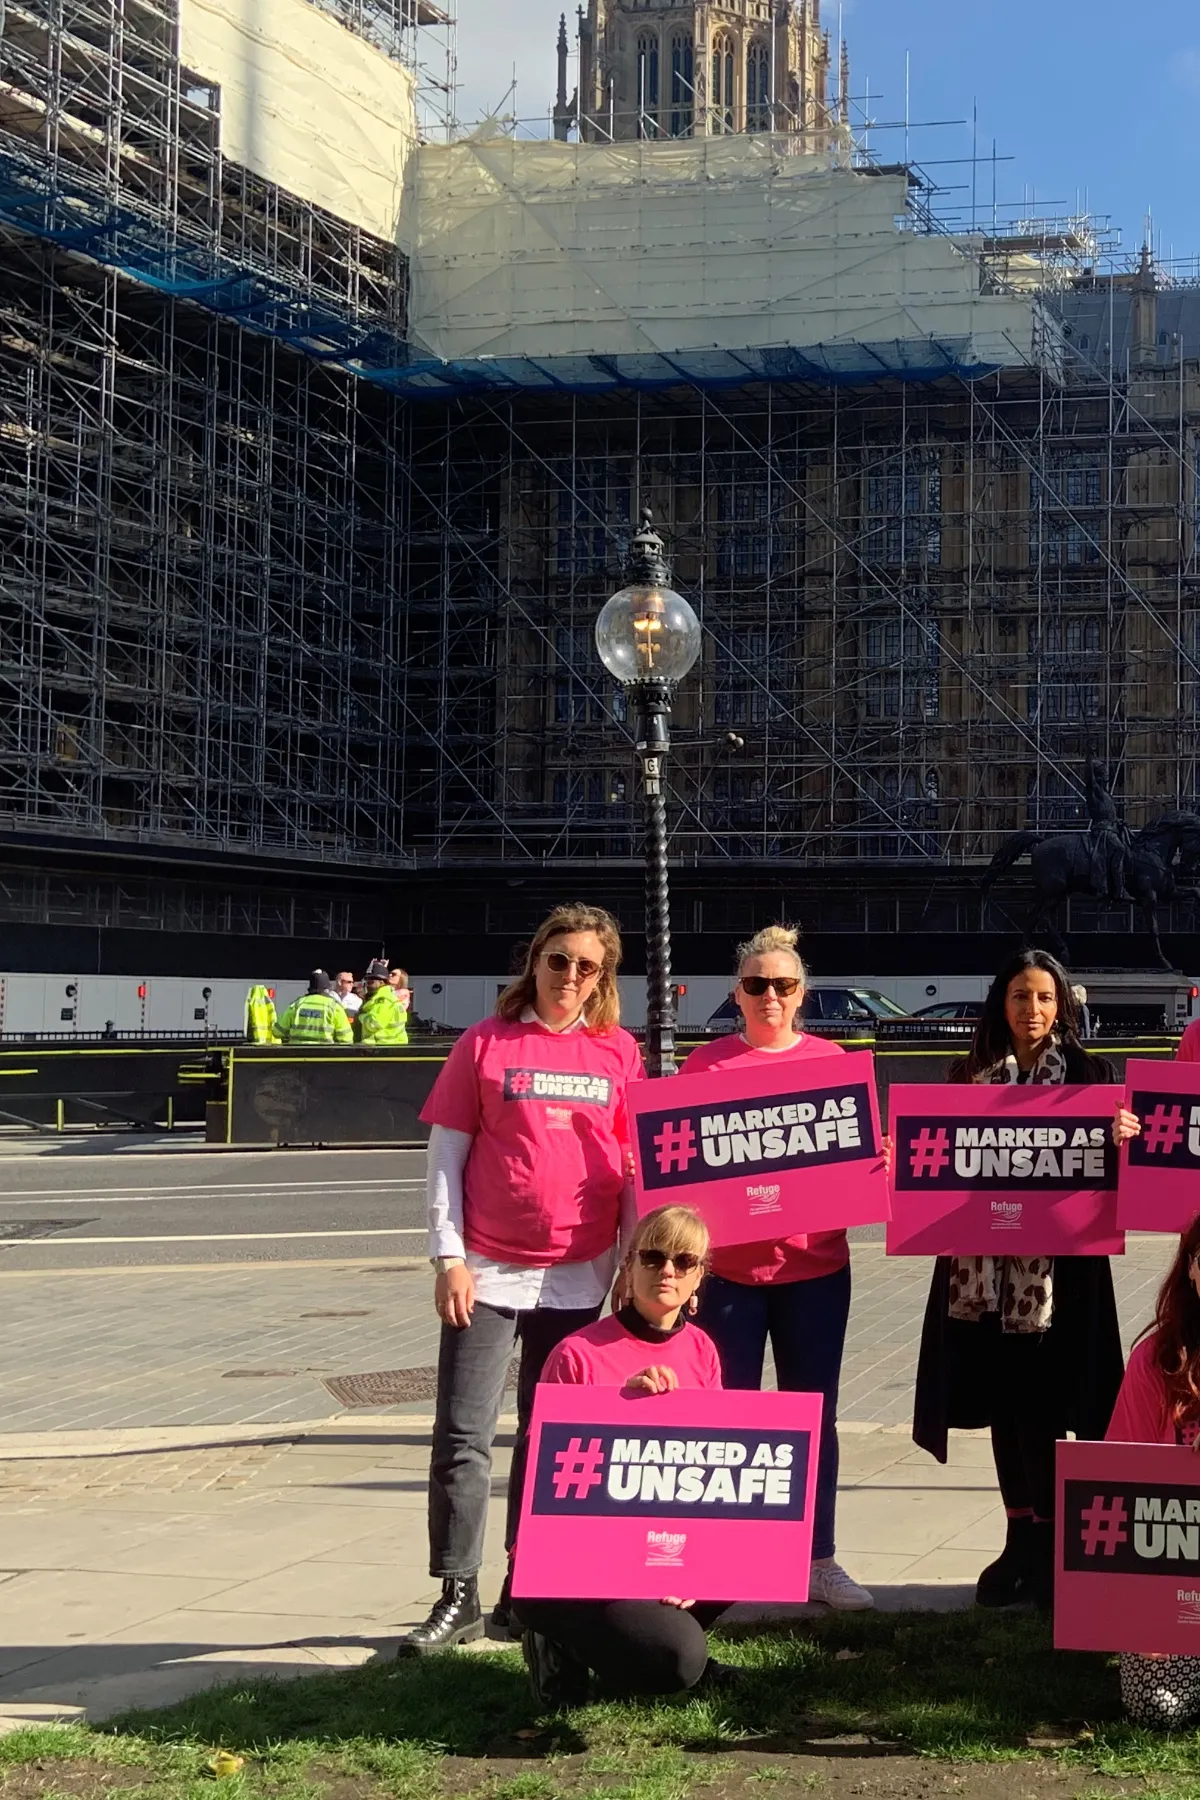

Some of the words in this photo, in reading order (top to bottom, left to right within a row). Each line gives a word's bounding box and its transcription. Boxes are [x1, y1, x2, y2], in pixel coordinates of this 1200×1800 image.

[647, 759, 654, 772] G
[533, 1073, 590, 1085] MARKED
[591, 1078, 608, 1087] AS
[533, 1081, 608, 1102] UNSAFE
[653, 1119, 697, 1174] #
[701, 1103, 817, 1137] MARKED
[821, 1096, 857, 1120] AS
[701, 1117, 861, 1167] UNSAFE
[1144, 1104, 1184, 1154] #
[910, 1128, 949, 1177] #
[955, 1128, 1067, 1147] MARKED
[1070, 1128, 1105, 1147] AS
[954, 1149, 1105, 1178] UNSAFE
[746, 1184, 780, 1196] Refuge
[991, 1201, 1022, 1212] Refuge
[552, 1437, 604, 1499] #
[610, 1438, 747, 1466] MARKED
[751, 1443, 794, 1468] AS
[607, 1464, 793, 1505] UNSAFE
[647, 1531, 687, 1544] Refuge
[1080, 1495, 1128, 1556] #
